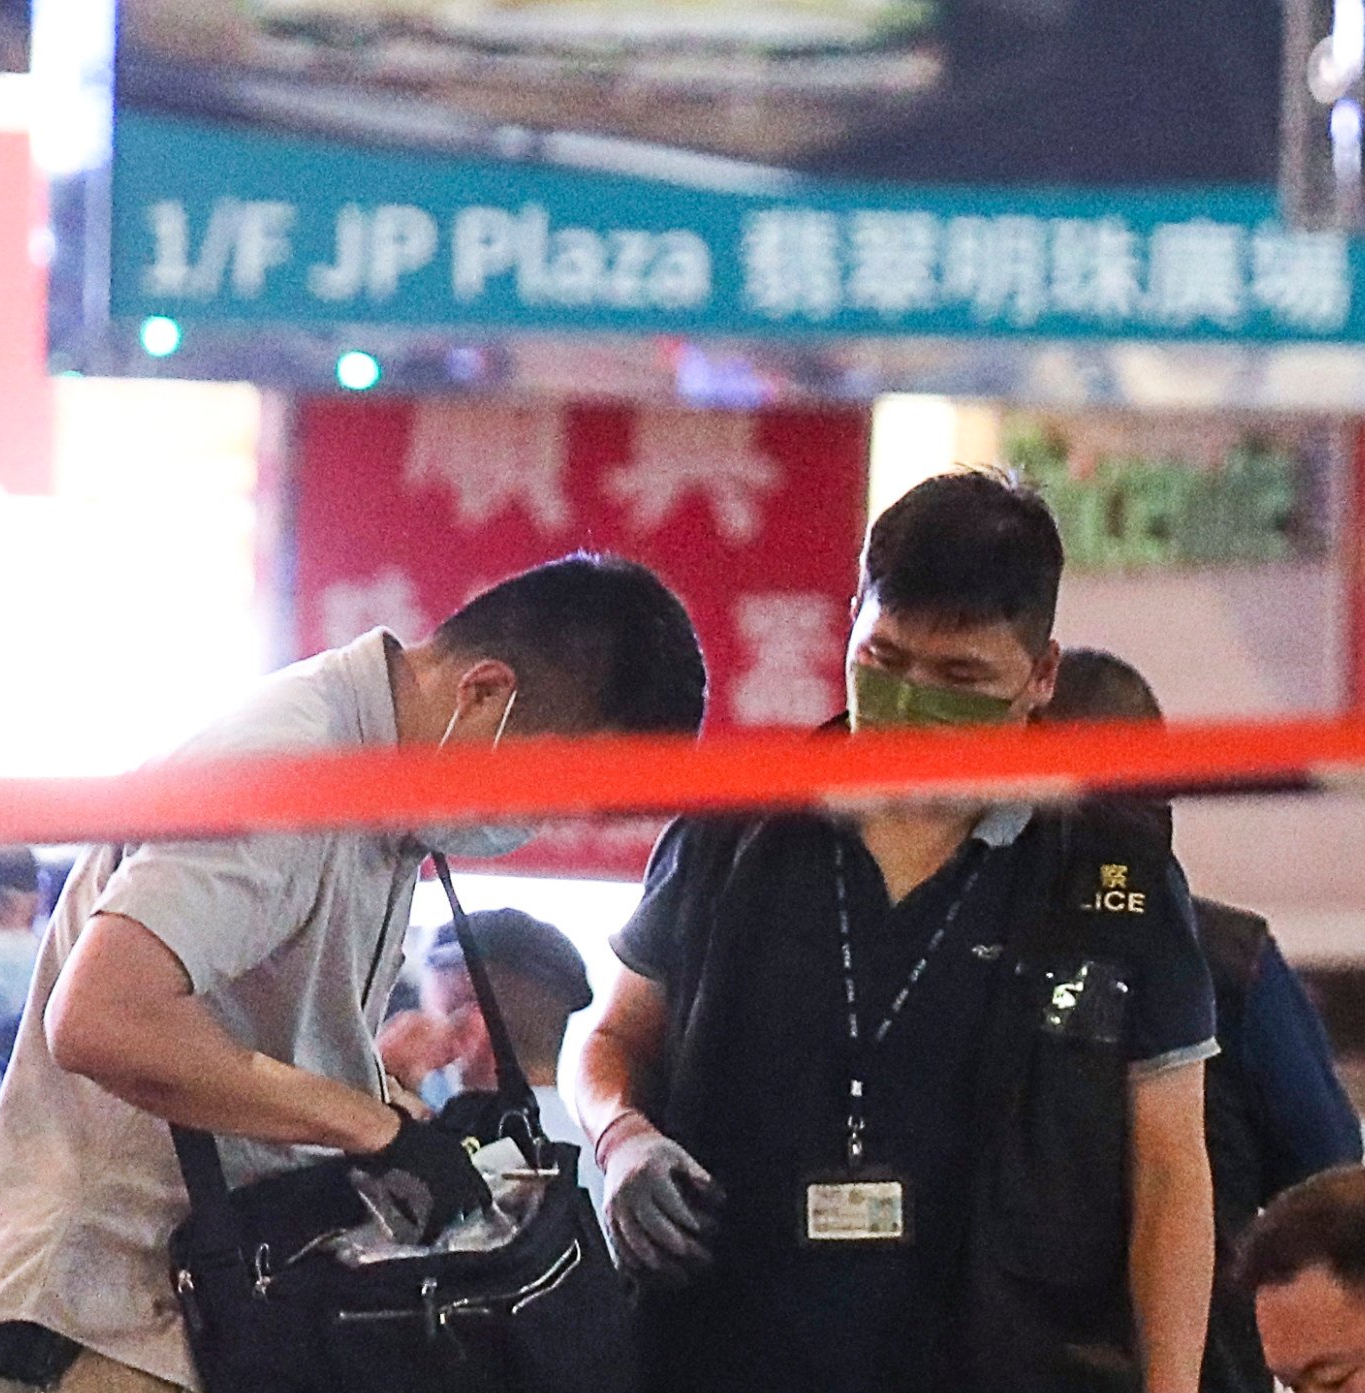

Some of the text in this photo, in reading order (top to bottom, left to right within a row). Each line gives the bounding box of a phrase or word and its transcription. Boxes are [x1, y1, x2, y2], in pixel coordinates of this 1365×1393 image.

[147, 198, 295, 300] 1/F
[309, 202, 437, 300] JP
[452, 202, 713, 310] Plaza
[1080, 891, 1146, 913] ICE
